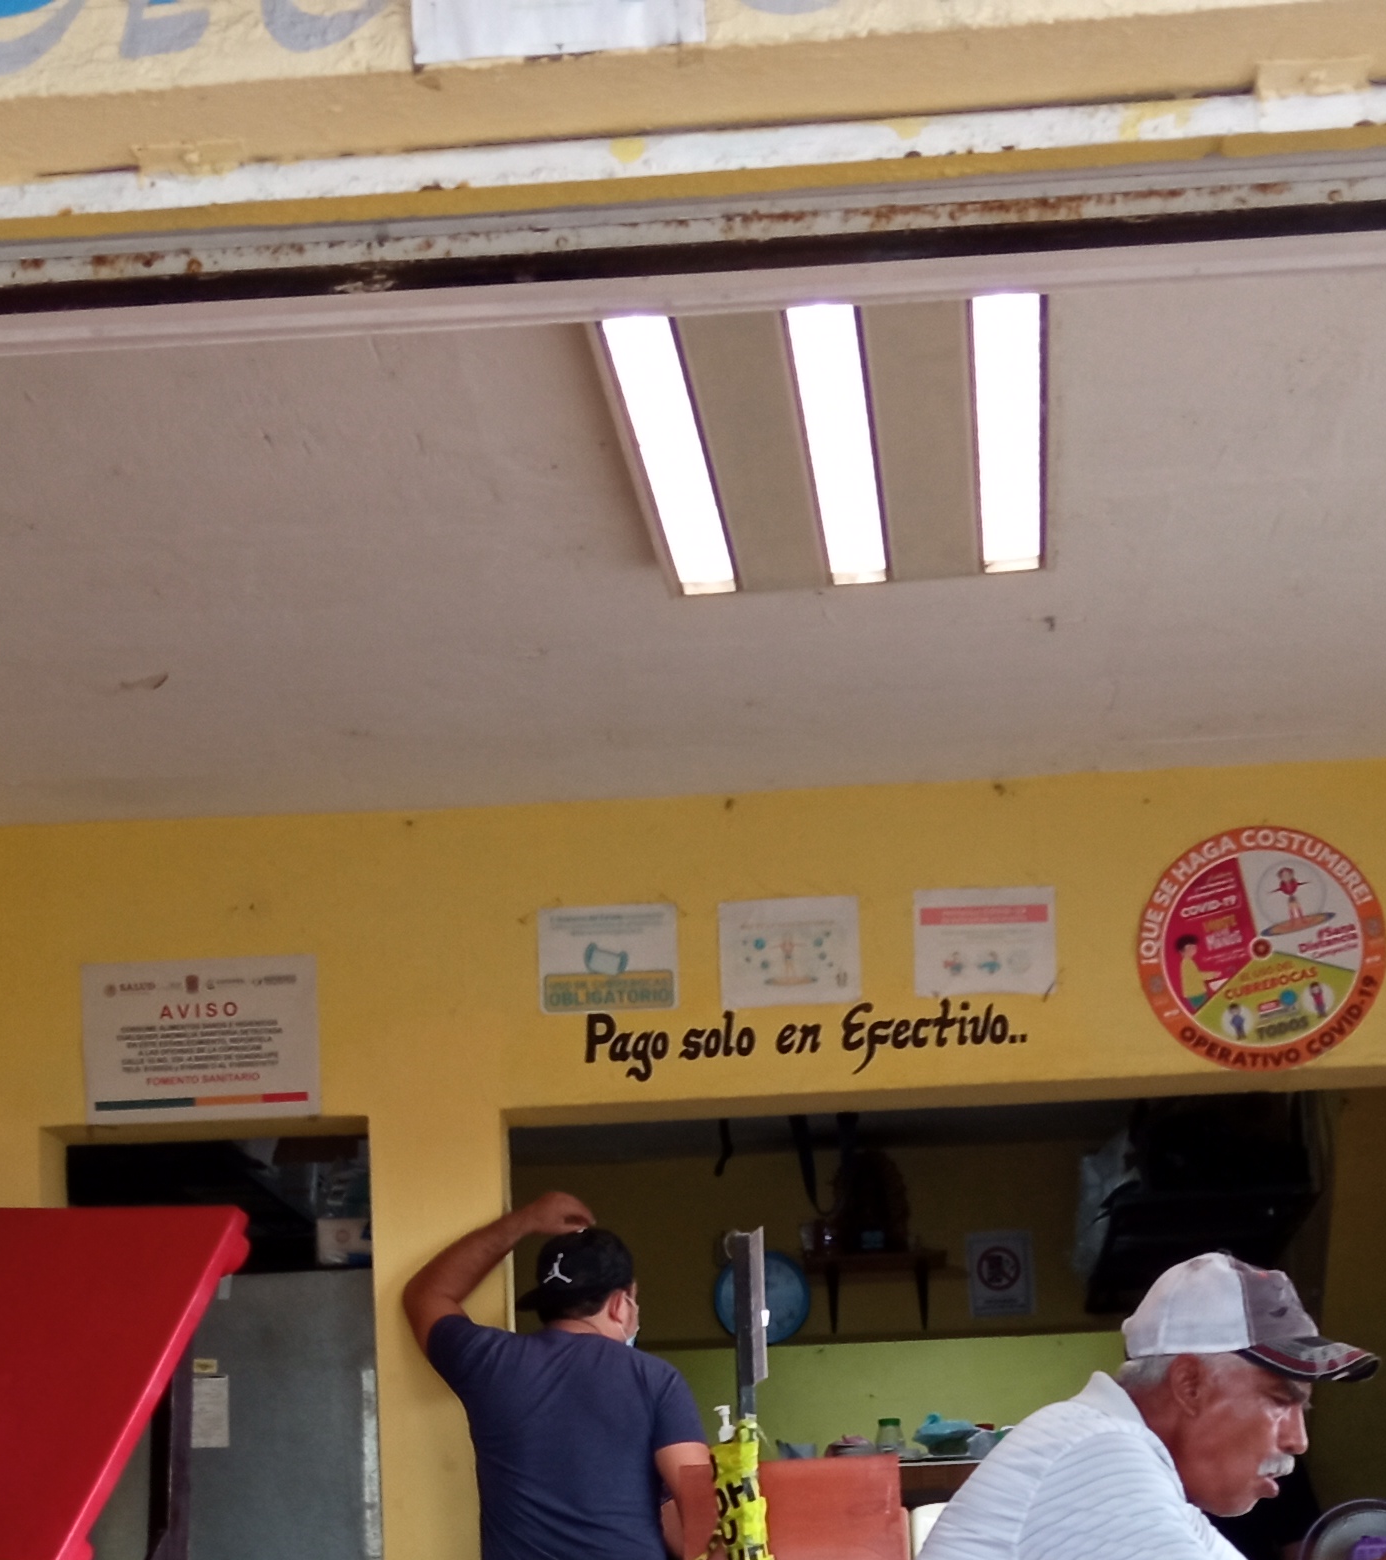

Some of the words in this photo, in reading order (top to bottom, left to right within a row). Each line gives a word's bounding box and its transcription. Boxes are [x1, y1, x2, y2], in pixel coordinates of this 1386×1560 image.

[1172, 835, 1237, 881] HAGA
[160, 1001, 239, 1020] AVISO
[1180, 1026, 1301, 1068] OPERATIVO
[1306, 975, 1377, 1053] COVID-19
[585, 1012, 669, 1081] Pago
[679, 1010, 756, 1061] solo
[775, 1021, 821, 1054] en
